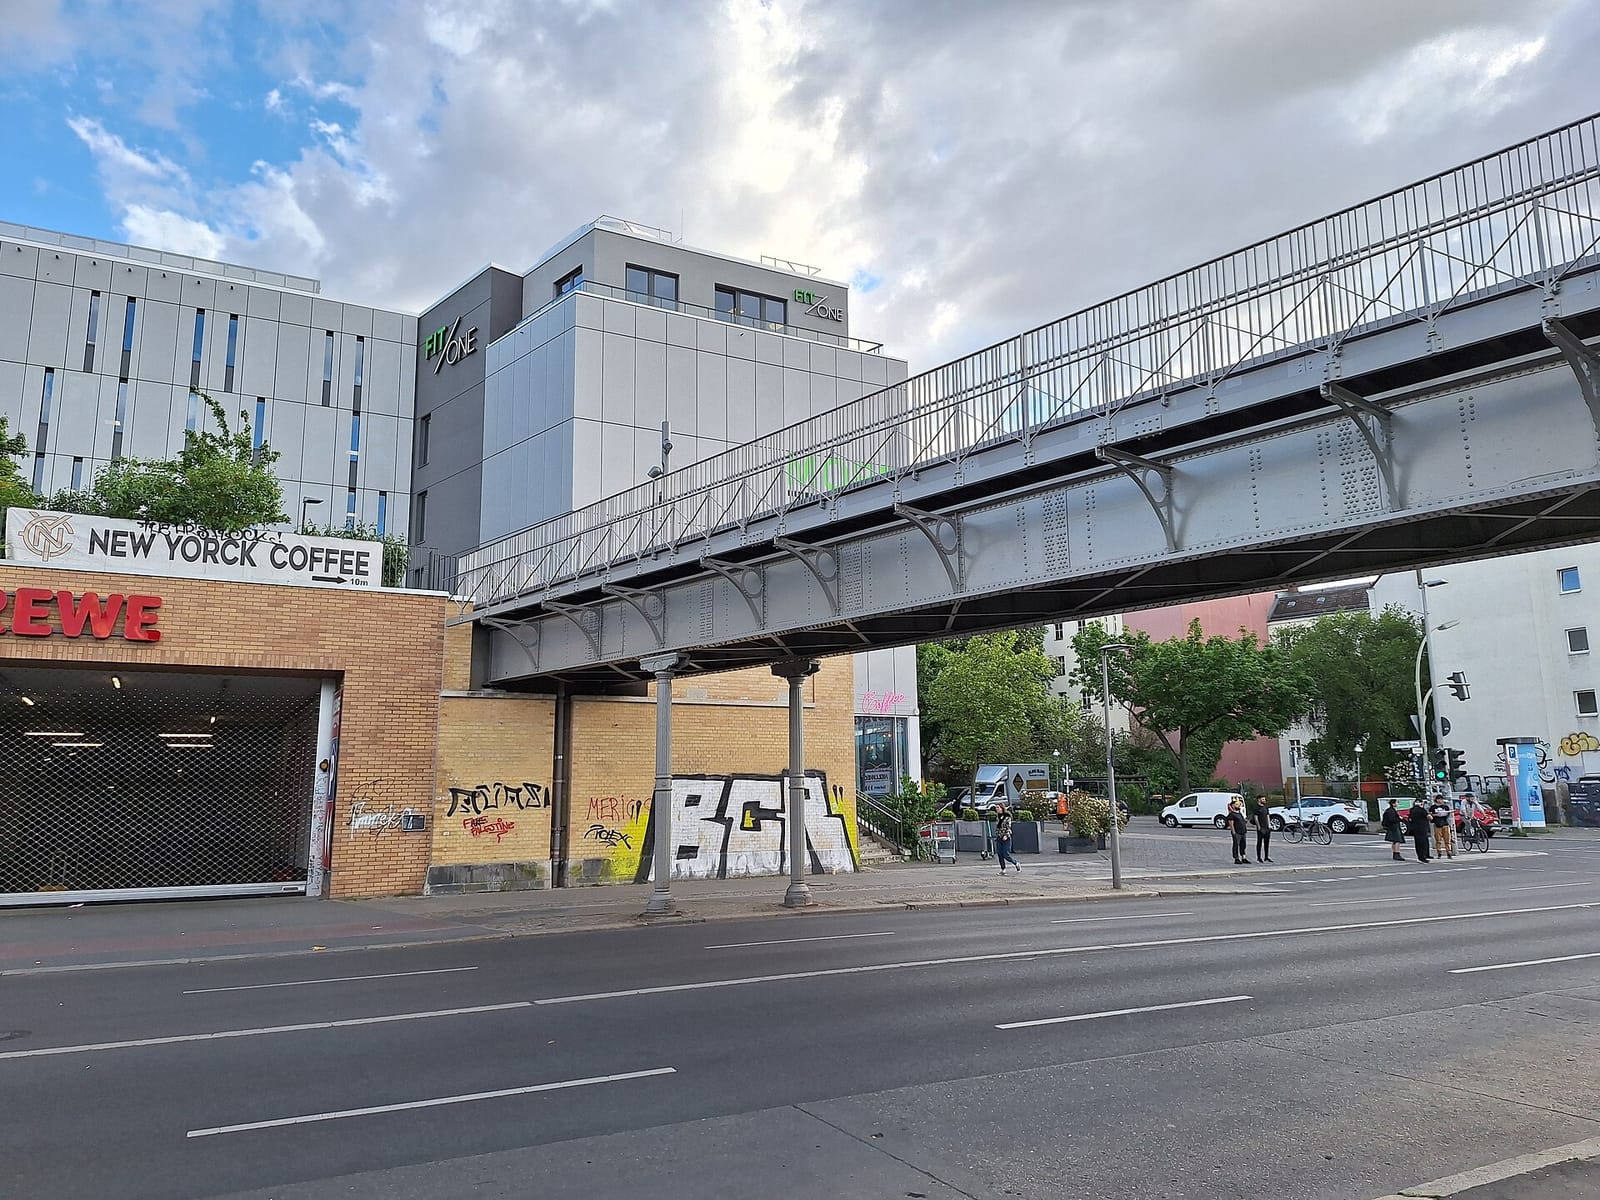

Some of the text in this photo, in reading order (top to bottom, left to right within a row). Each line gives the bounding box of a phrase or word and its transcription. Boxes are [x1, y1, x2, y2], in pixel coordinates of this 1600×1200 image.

[88, 527, 370, 577] NEW YORCK COFFEE
[350, 577, 369, 587] 10m
[0, 587, 162, 642] EWE
